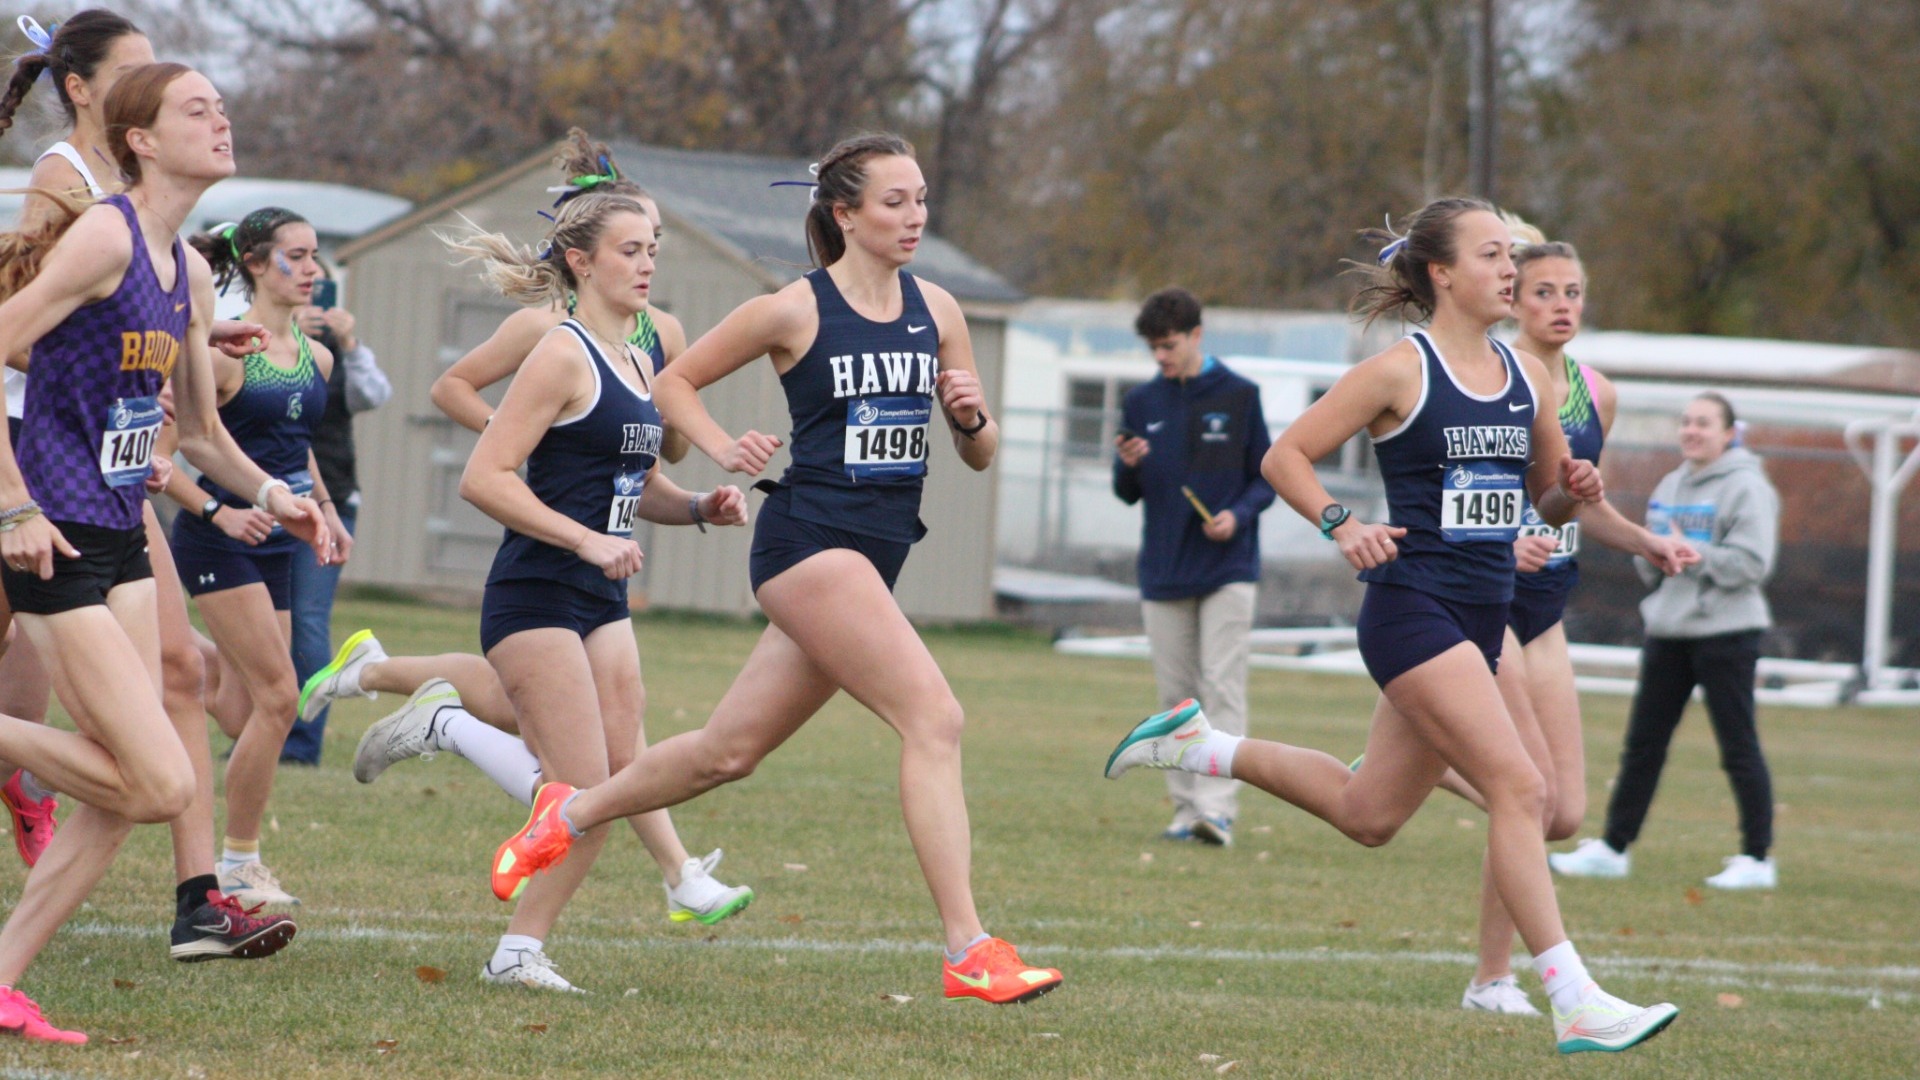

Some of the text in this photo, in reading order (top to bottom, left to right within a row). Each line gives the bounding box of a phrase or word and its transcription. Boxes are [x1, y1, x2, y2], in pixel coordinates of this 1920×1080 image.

[856, 426, 925, 460] 1498
[1443, 425, 1528, 459] HAWKS
[1452, 491, 1515, 525] 1496
